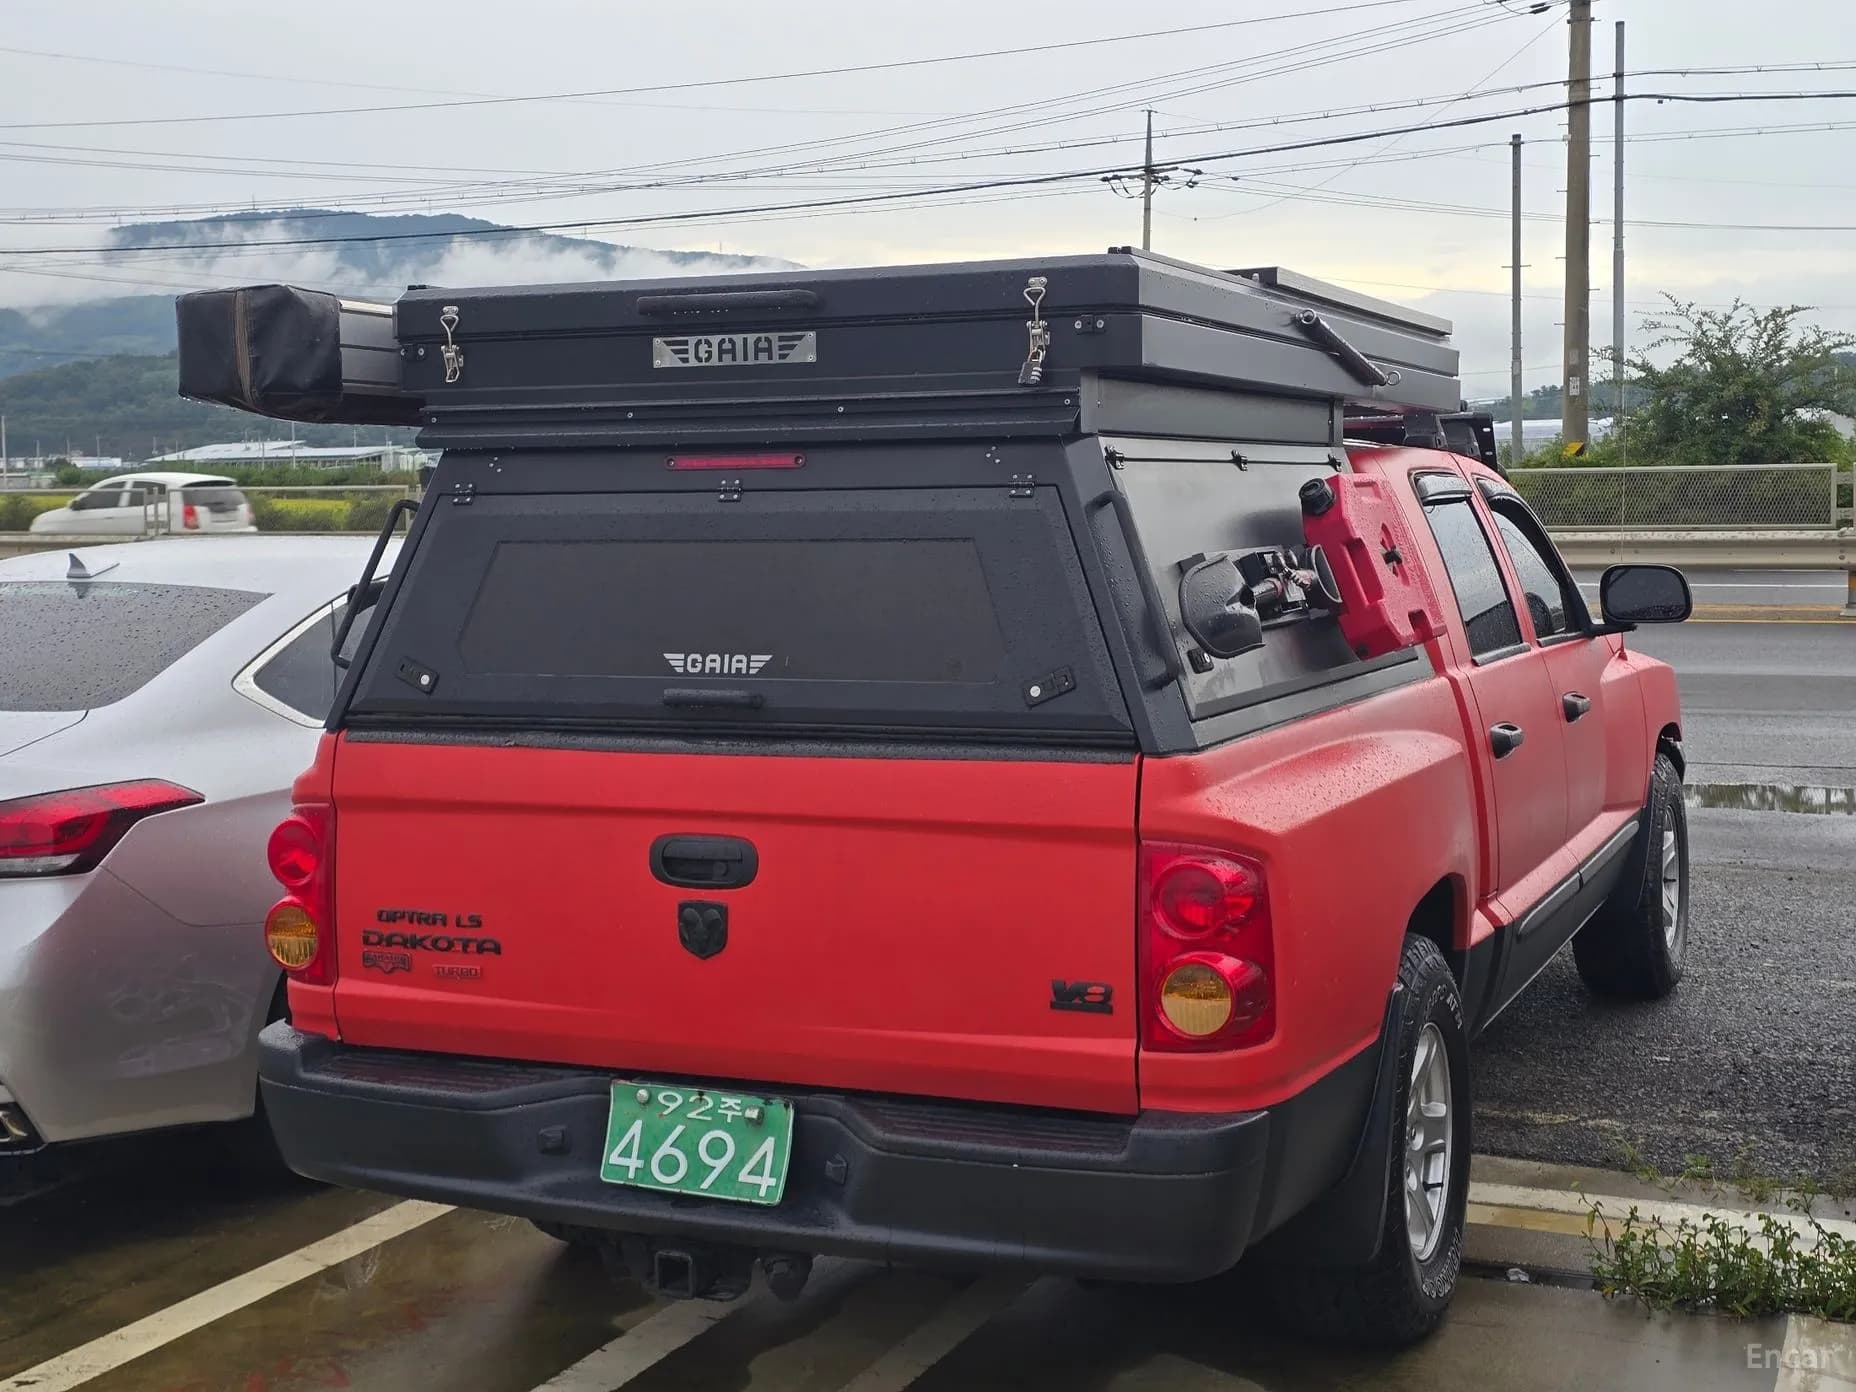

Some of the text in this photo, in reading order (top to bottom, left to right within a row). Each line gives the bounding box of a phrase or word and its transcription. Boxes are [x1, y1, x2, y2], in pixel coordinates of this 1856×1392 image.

[694, 336, 774, 364] GAIA
[686, 653, 748, 674] GAIA
[455, 913, 482, 928] LS
[362, 930, 501, 955] DAKOTA
[657, 1091, 743, 1123] 92주
[608, 1119, 777, 1198] 4694
